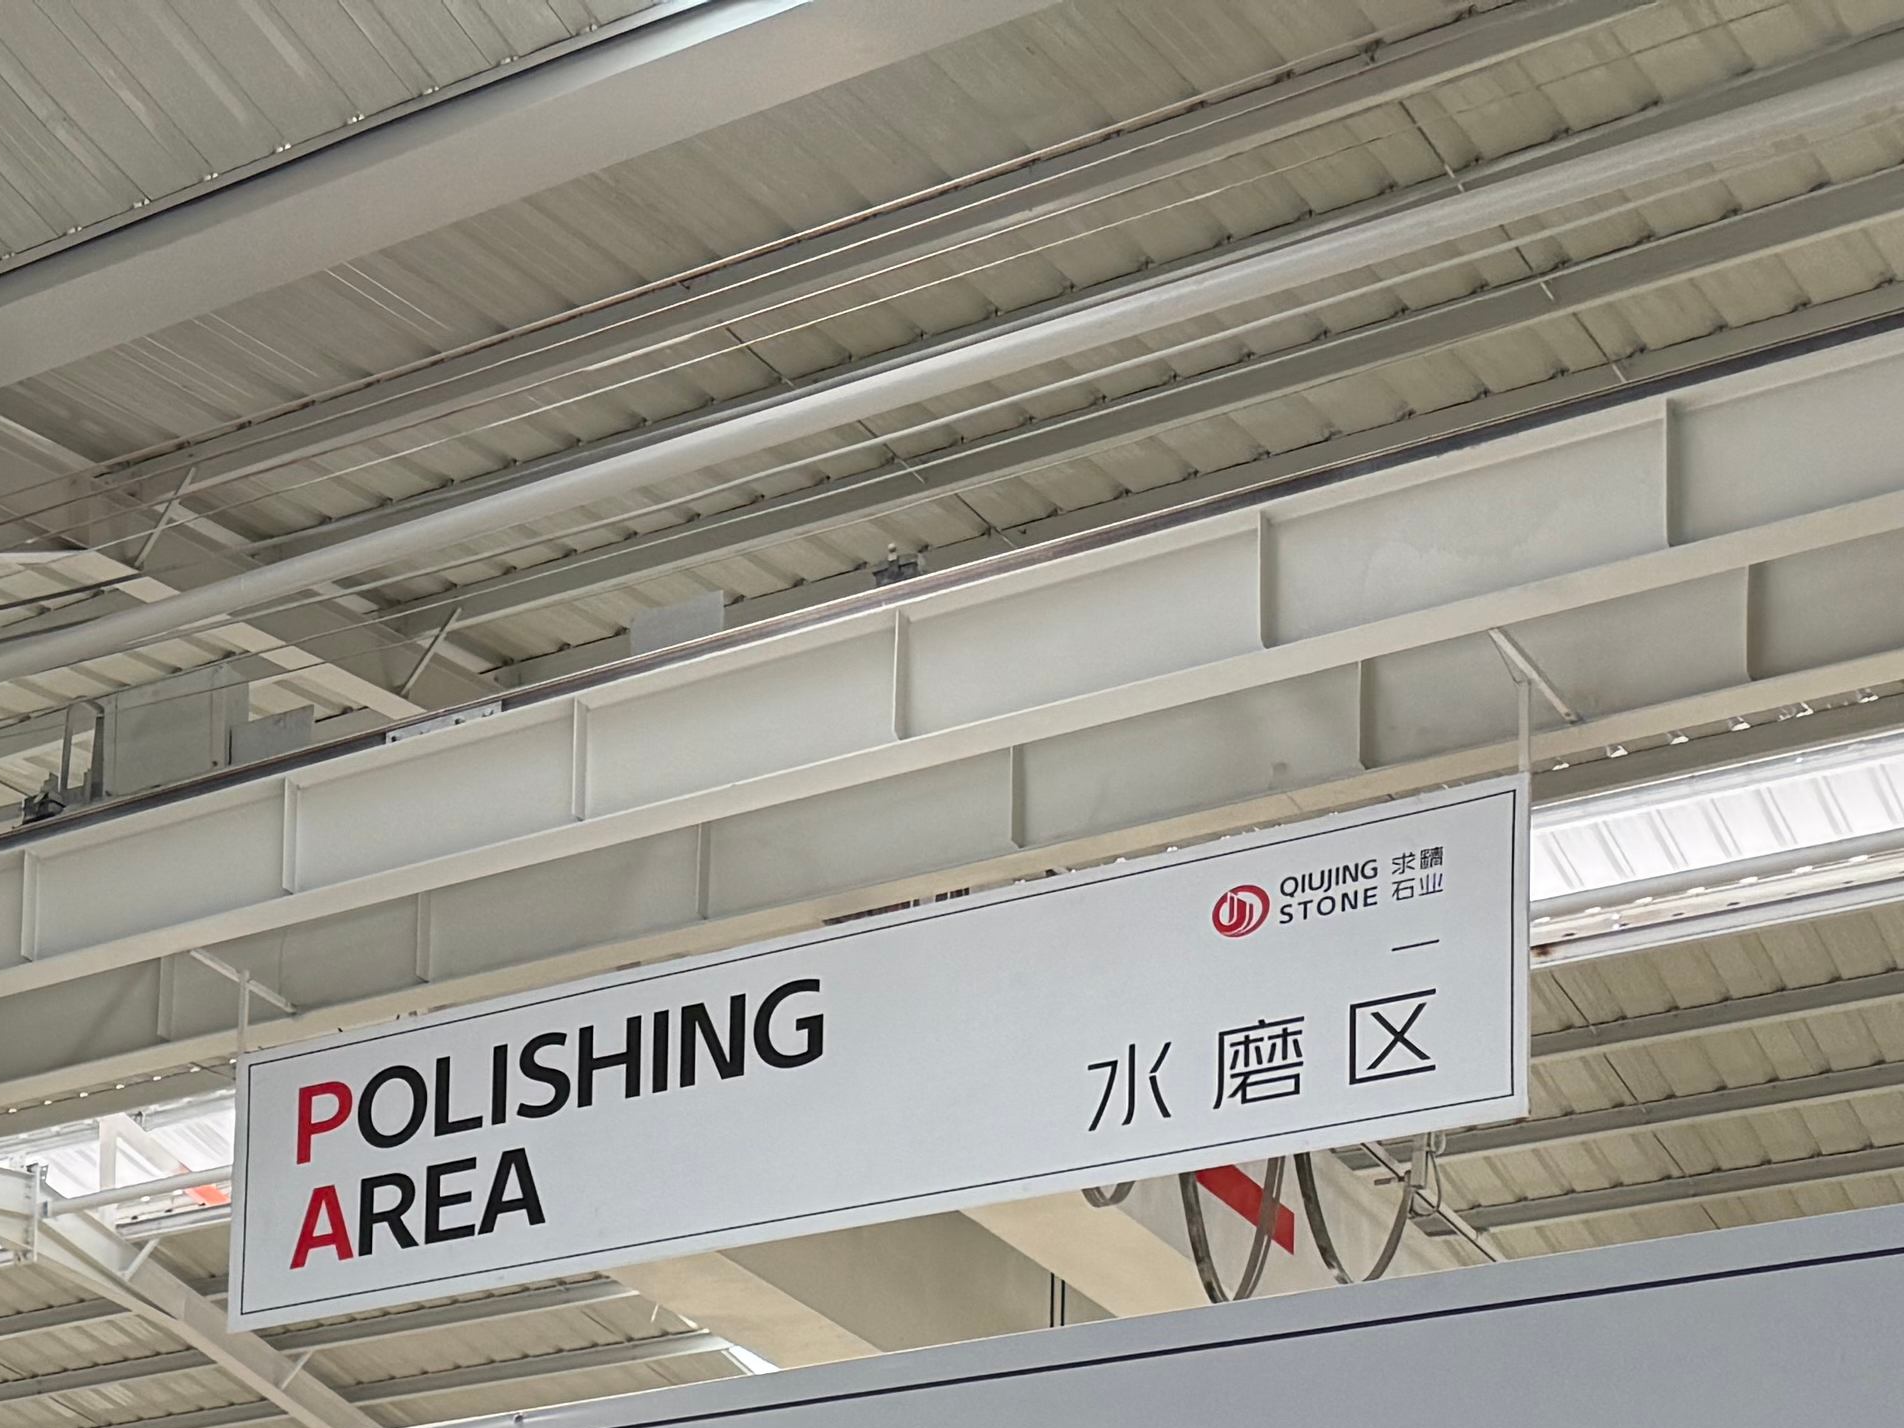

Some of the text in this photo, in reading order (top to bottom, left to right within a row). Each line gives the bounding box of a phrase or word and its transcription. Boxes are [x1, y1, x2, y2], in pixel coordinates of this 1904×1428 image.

[1279, 859, 1379, 897] QIUJING
[1279, 886, 1379, 924] STONE
[1391, 872, 1444, 901] 石业
[296, 979, 826, 1165] POLISHING
[1087, 989, 1438, 1132] 水磨区
[290, 1148, 547, 1270] AREA
